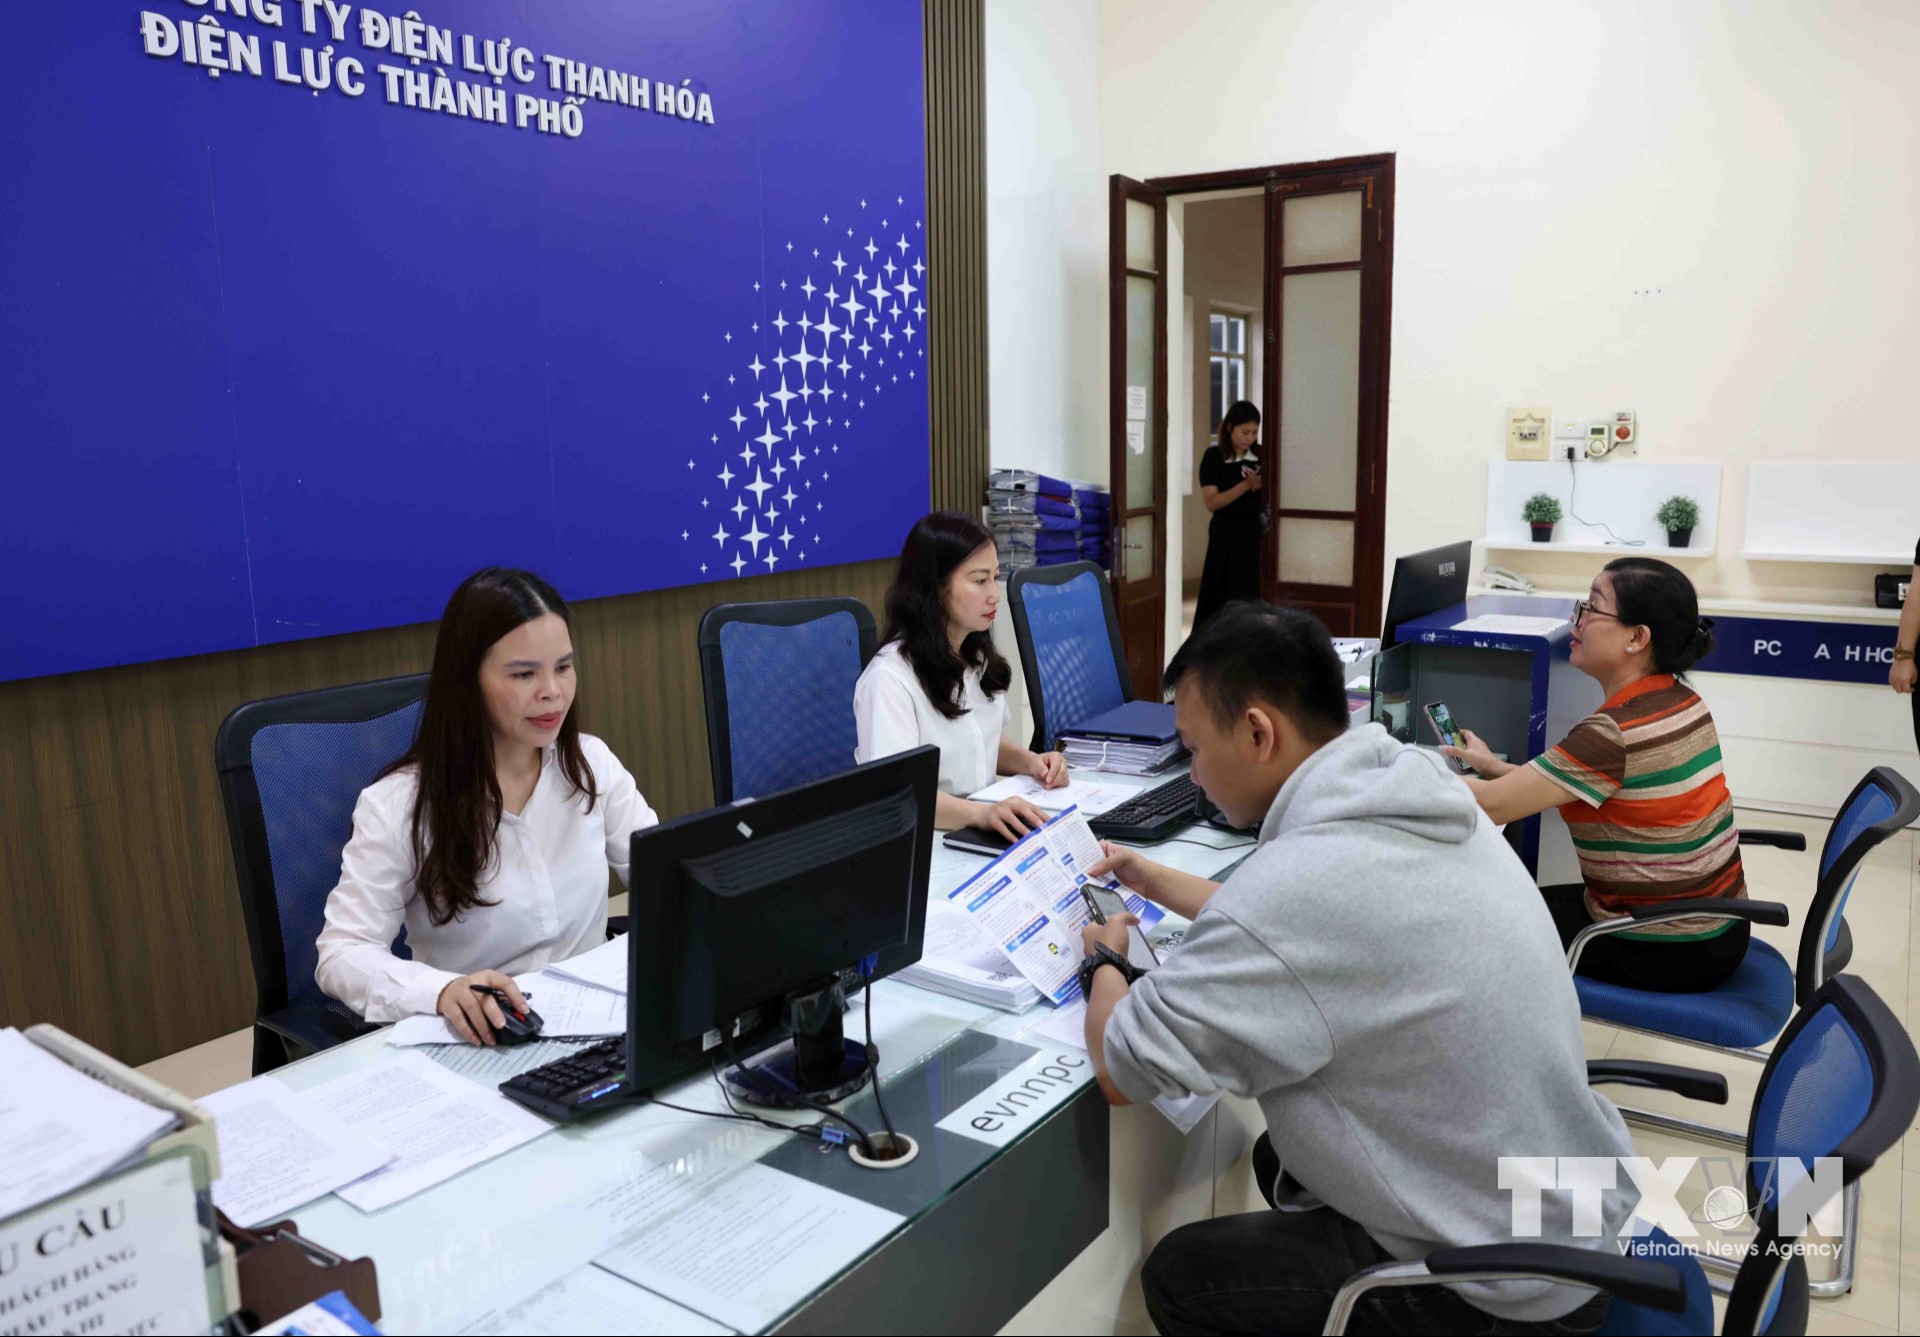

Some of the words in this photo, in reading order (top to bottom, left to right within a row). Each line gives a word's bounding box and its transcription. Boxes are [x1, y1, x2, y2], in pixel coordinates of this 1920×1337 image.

[140, 10, 263, 77] ĐIỆN
[272, 40, 365, 97] LỰC
[377, 62, 507, 123] THÀNH
[515, 93, 587, 137] PHỐ
[297, 0, 351, 40] TY
[359, 8, 454, 65] ĐIỆN
[461, 34, 535, 84] LỰC
[543, 54, 650, 109] THANH
[655, 78, 714, 124] HÓA
[1754, 639, 1782, 655] PC
[970, 1055, 1085, 1132] evnnpc
